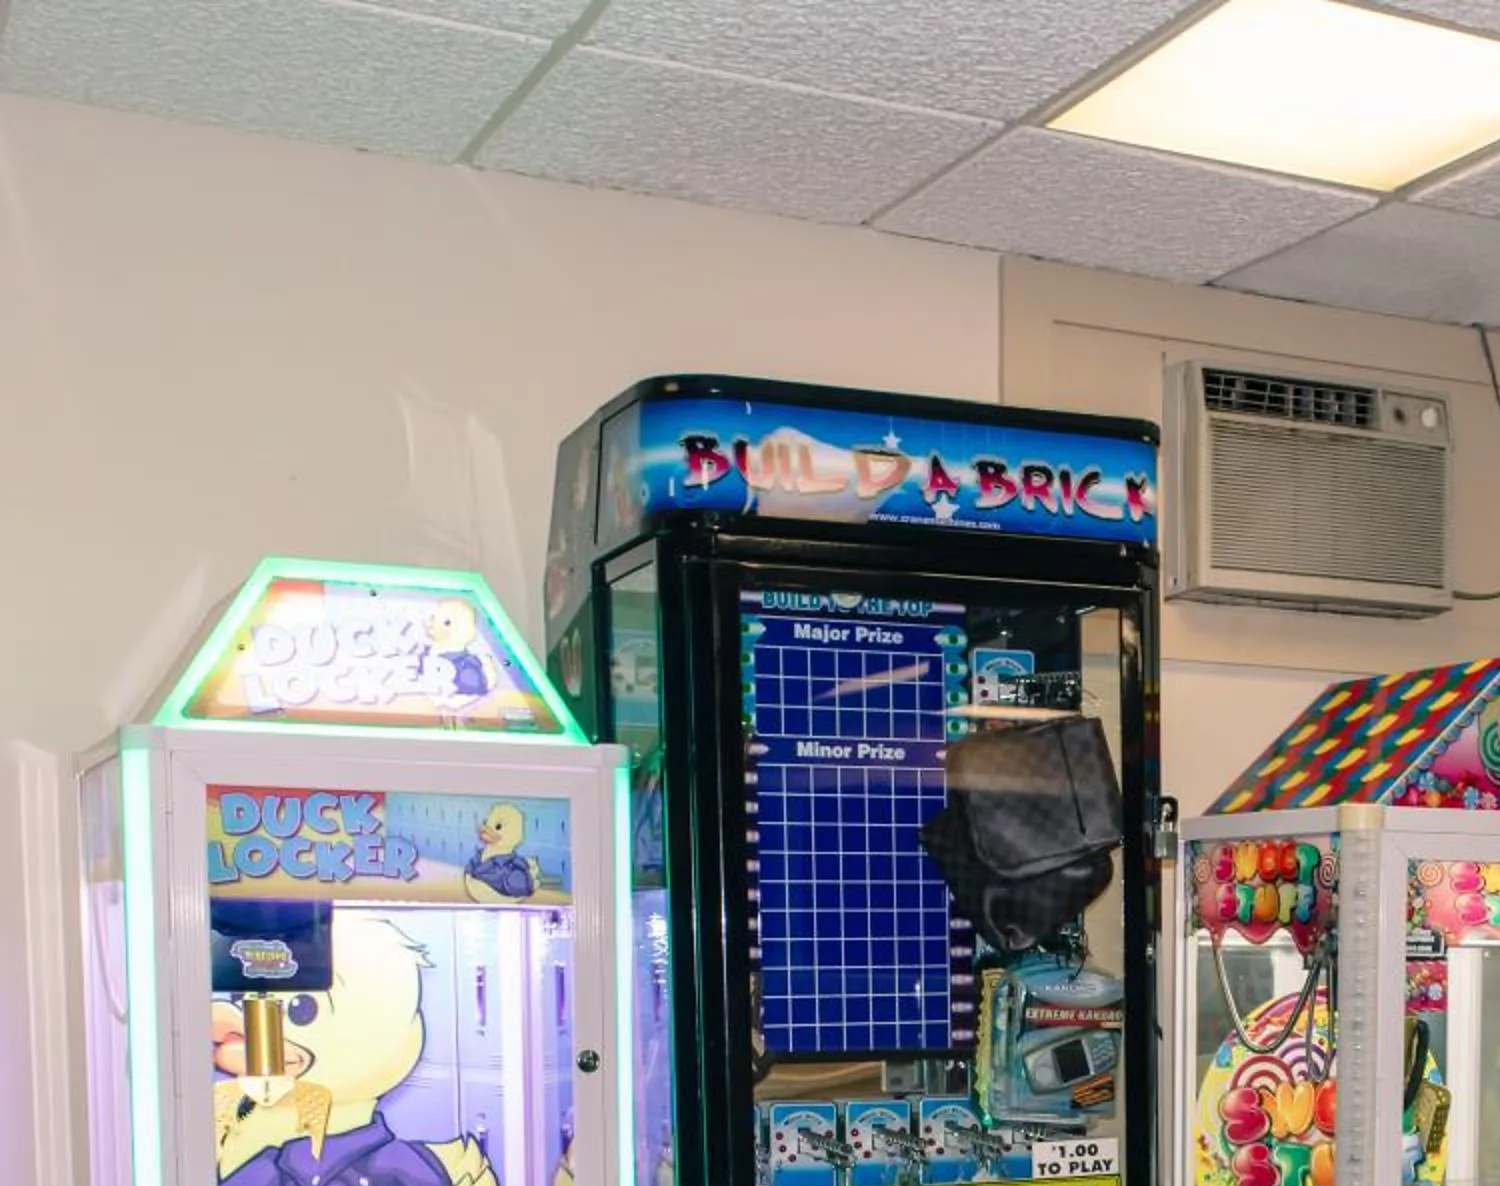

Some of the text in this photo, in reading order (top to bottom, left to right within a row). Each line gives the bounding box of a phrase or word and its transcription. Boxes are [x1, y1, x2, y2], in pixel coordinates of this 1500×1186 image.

[679, 433, 911, 498] BUILD
[926, 455, 961, 502] A
[868, 512, 1002, 530] www.cranemhines.com
[761, 590, 823, 611] BUILD
[793, 623, 904, 645] Major Prize
[796, 741, 906, 761] Minor Prize
[219, 791, 383, 837] DUCK
[208, 833, 420, 883] LOCKER
[1038, 1159, 1114, 1176] TO PLAY
